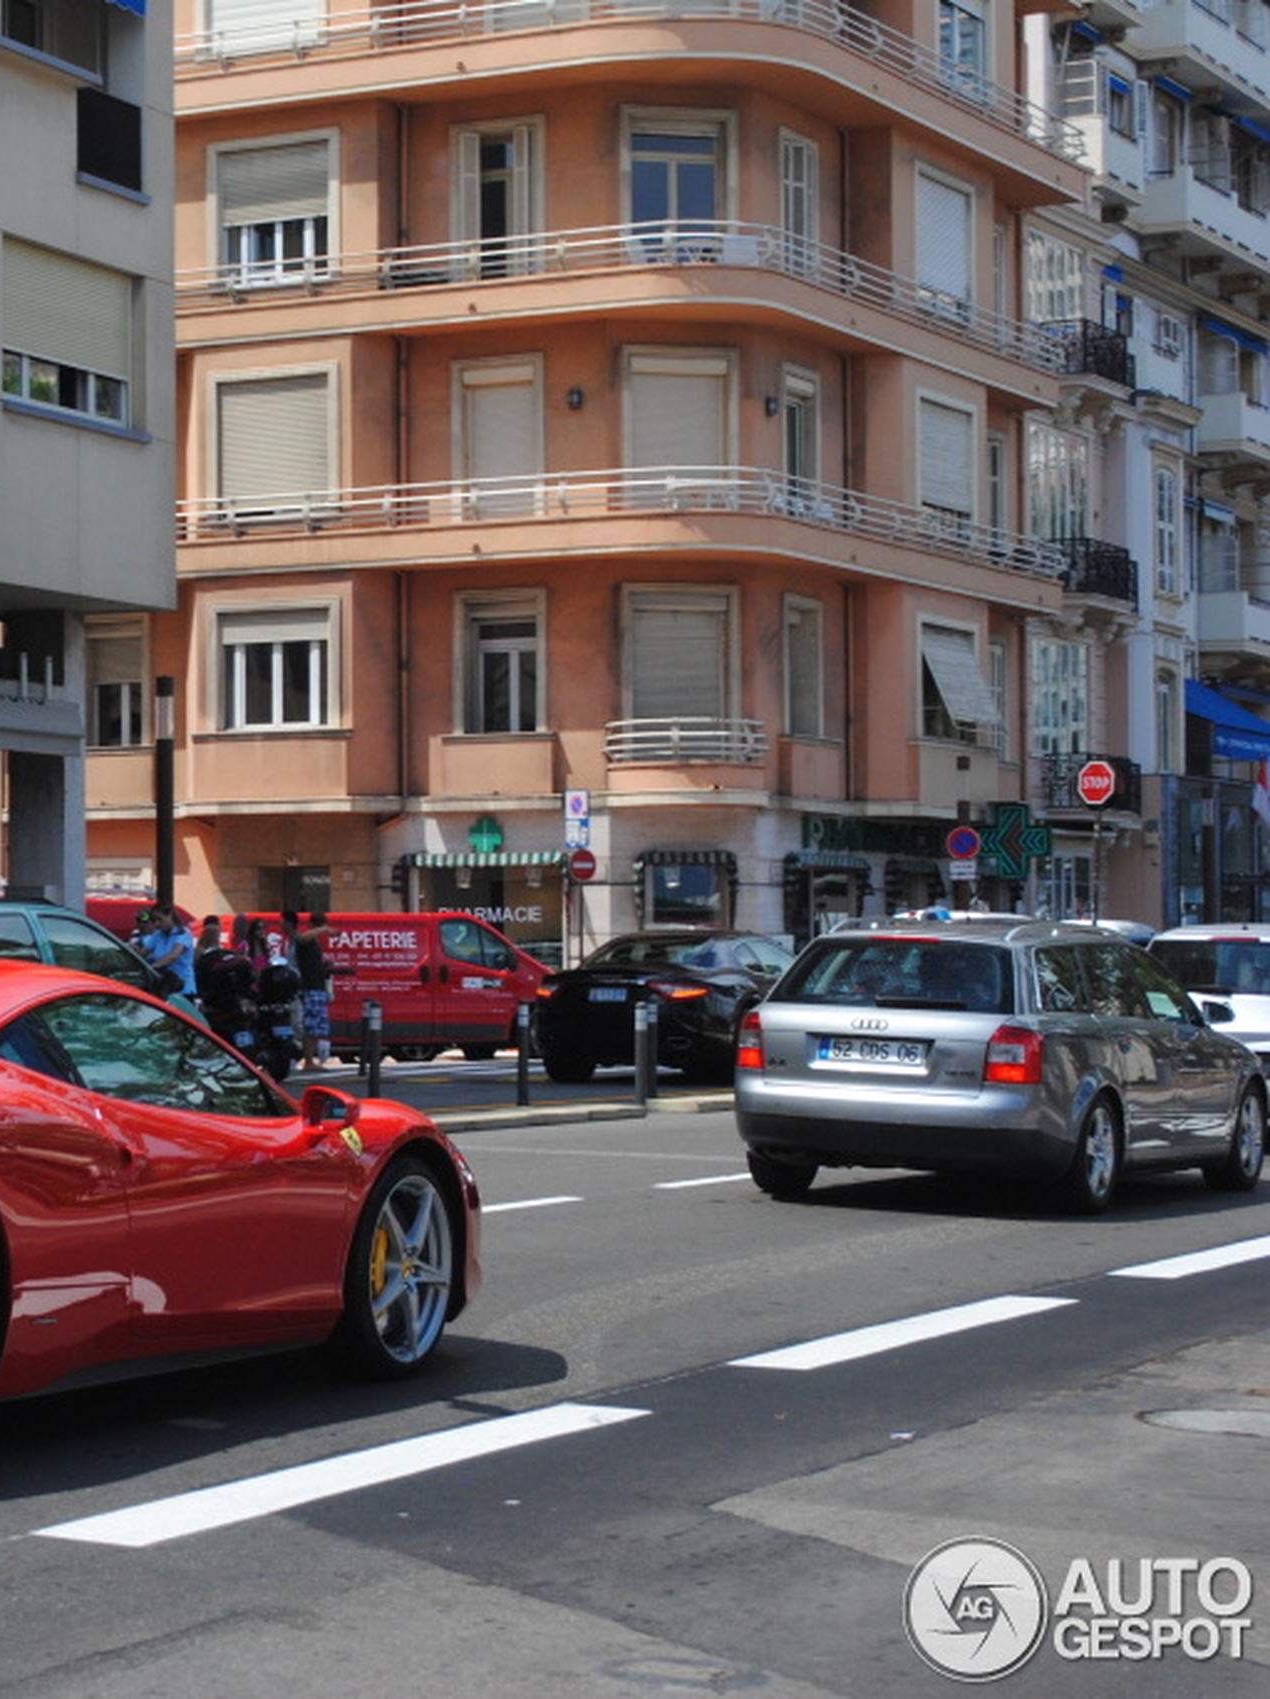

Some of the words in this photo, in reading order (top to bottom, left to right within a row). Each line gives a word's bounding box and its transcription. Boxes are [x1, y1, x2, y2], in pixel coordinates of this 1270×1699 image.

[1083, 776, 1109, 789] STOP
[833, 1040, 854, 1059] 52
[859, 1041, 890, 1061] CDS
[896, 1043, 919, 1063] 06
